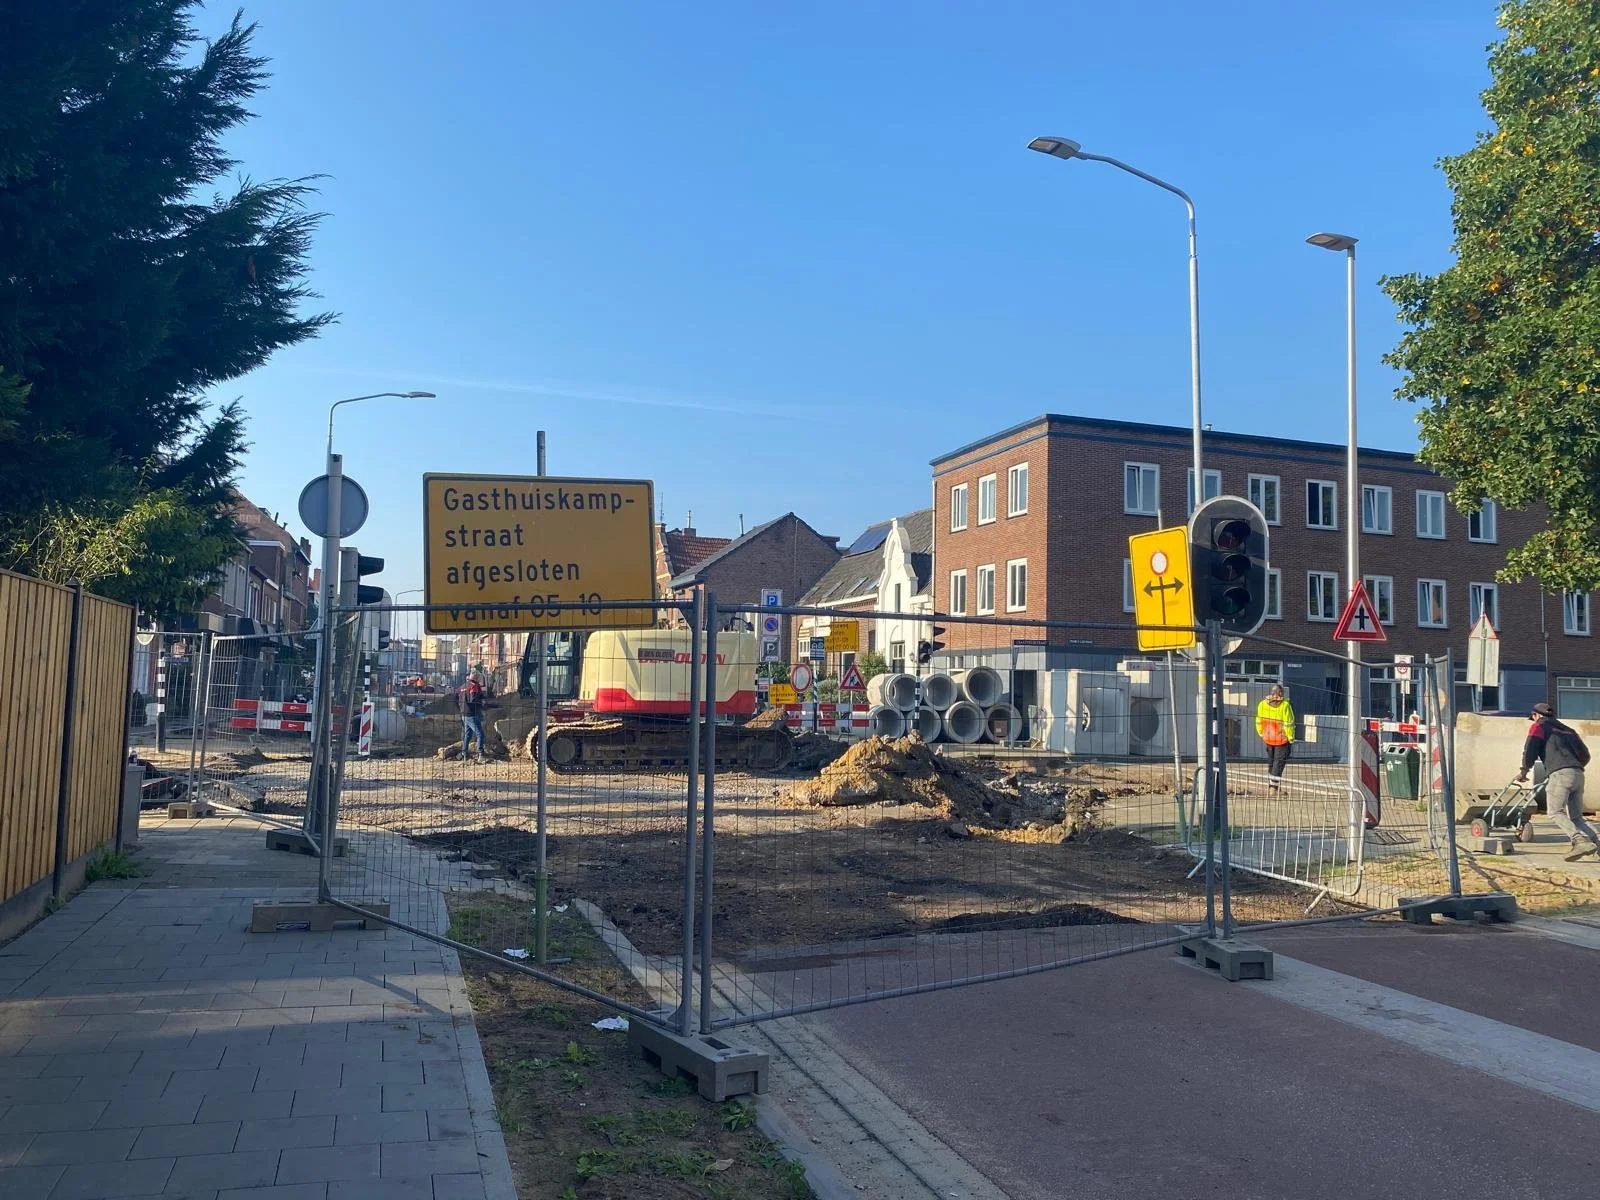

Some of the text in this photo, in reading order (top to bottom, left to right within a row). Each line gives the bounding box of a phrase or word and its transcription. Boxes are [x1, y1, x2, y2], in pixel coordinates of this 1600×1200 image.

[443, 487, 635, 514] Gasthuiskamp-
[445, 523, 524, 548] straat
[446, 559, 580, 590] afgesloten
